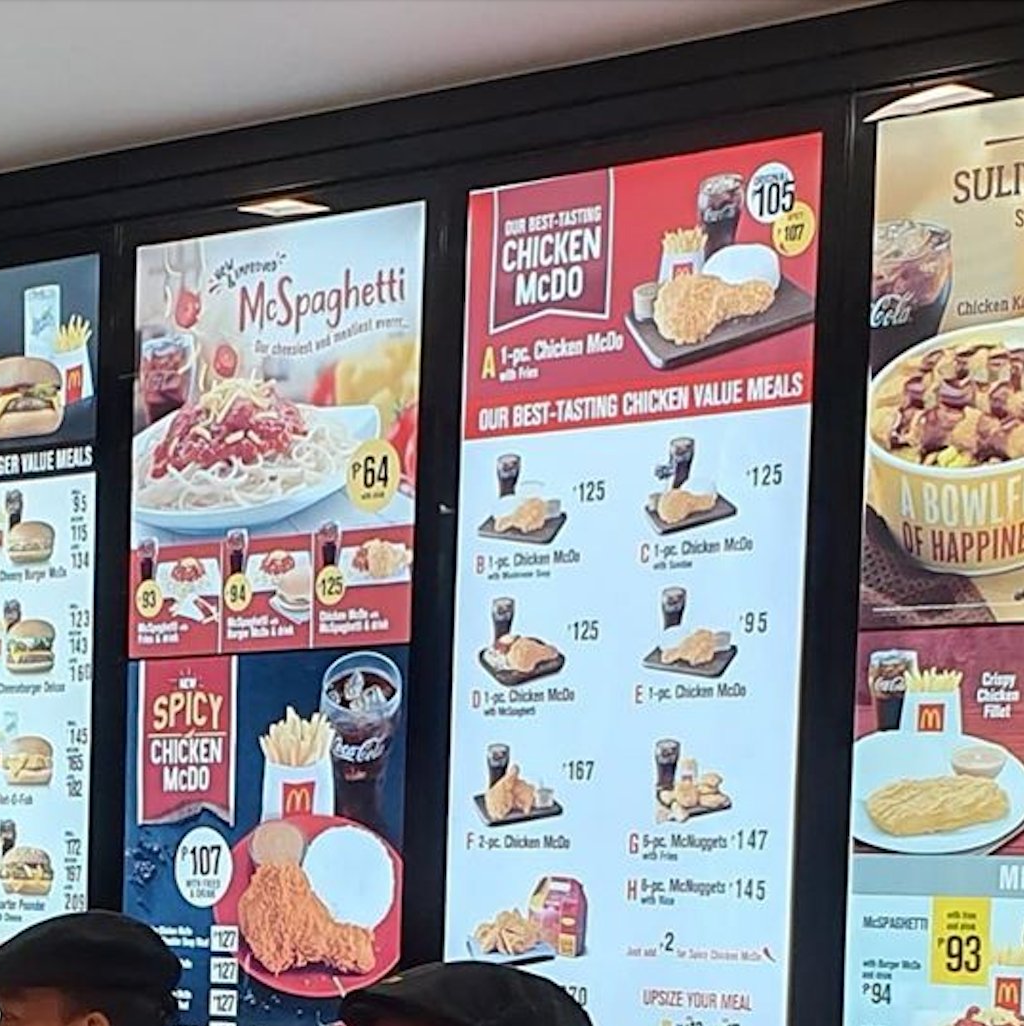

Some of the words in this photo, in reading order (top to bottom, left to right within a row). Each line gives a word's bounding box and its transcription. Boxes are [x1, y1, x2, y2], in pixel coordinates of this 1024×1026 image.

[504, 218, 527, 235] OUR
[528, 204, 602, 231] BEST-TASTING
[502, 226, 602, 271] CHICKEN
[515, 266, 584, 306] McDO
[239, 267, 406, 334] McSpaghetti
[957, 298, 1009, 317] Chicken
[482, 346, 496, 379] A
[534, 338, 583, 361] Chicken
[587, 330, 625, 354] McDo
[478, 406, 509, 430] OUR
[512, 393, 618, 428] BEST-TASTING
[622, 385, 689, 414] CHICKEN
[694, 379, 743, 405] VALUE
[747, 371, 804, 400] MEALS
[22, 450, 54, 471] VALUE
[56, 446, 93, 468] MEALS
[901, 475, 915, 518] A
[682, 541, 721, 554] Chicken
[724, 538, 754, 552] McDo
[902, 522, 923, 555] OF
[513, 552, 550, 566] Chicken
[553, 550, 580, 564] McDo
[676, 686, 714, 698] Chicken
[717, 684, 746, 698] McDo
[982, 672, 1016, 689] Crispy
[509, 689, 545, 703] Chicken
[548, 687, 575, 702] McDo
[977, 690, 1019, 703] Chicken
[153, 693, 223, 731] SPICY
[983, 704, 1011, 719] Fillet
[151, 737, 223, 764] CHICKEN
[163, 767, 210, 792] McDO
[504, 835, 541, 849] Chicken
[543, 836, 571, 850] McDo
[671, 834, 727, 852] McNuggets
[627, 880, 638, 900] H
[670, 880, 725, 894] McNuggets
[643, 990, 683, 1007] UPSIZE
[687, 991, 717, 1009] YOUR
[720, 992, 751, 1010] MEAL
